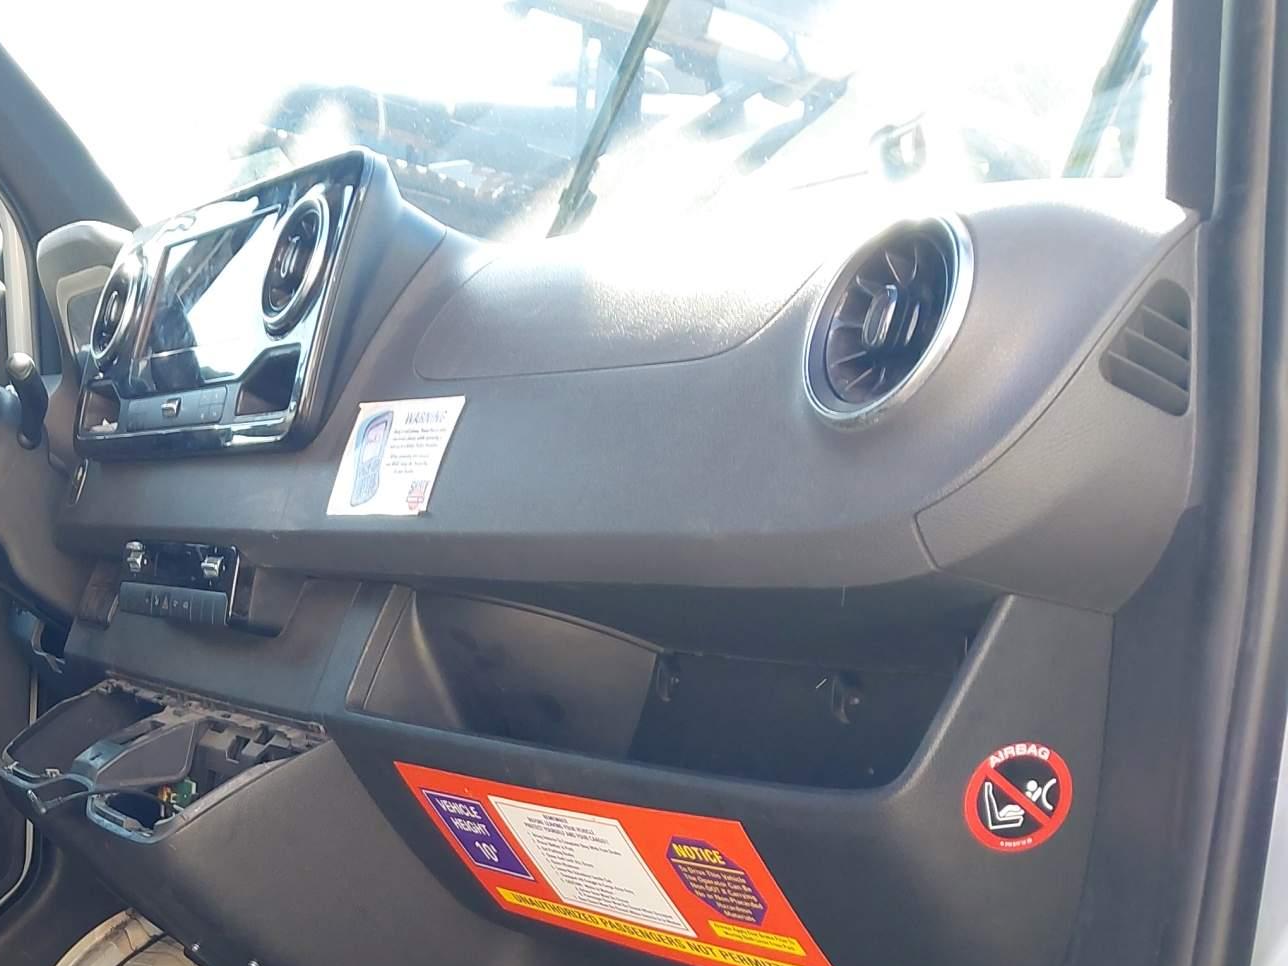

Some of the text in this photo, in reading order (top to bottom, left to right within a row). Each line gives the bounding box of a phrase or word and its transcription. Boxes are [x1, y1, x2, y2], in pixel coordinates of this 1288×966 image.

[988, 743, 1051, 768] AIRBAG
[435, 798, 482, 820] VEHICLE
[450, 817, 491, 837] HEIGHT
[671, 843, 726, 865] NOTICE
[512, 892, 599, 925] UNAUTHORIZED
[599, 913, 686, 949] PASSENGERS
[685, 935, 718, 958] NOT
